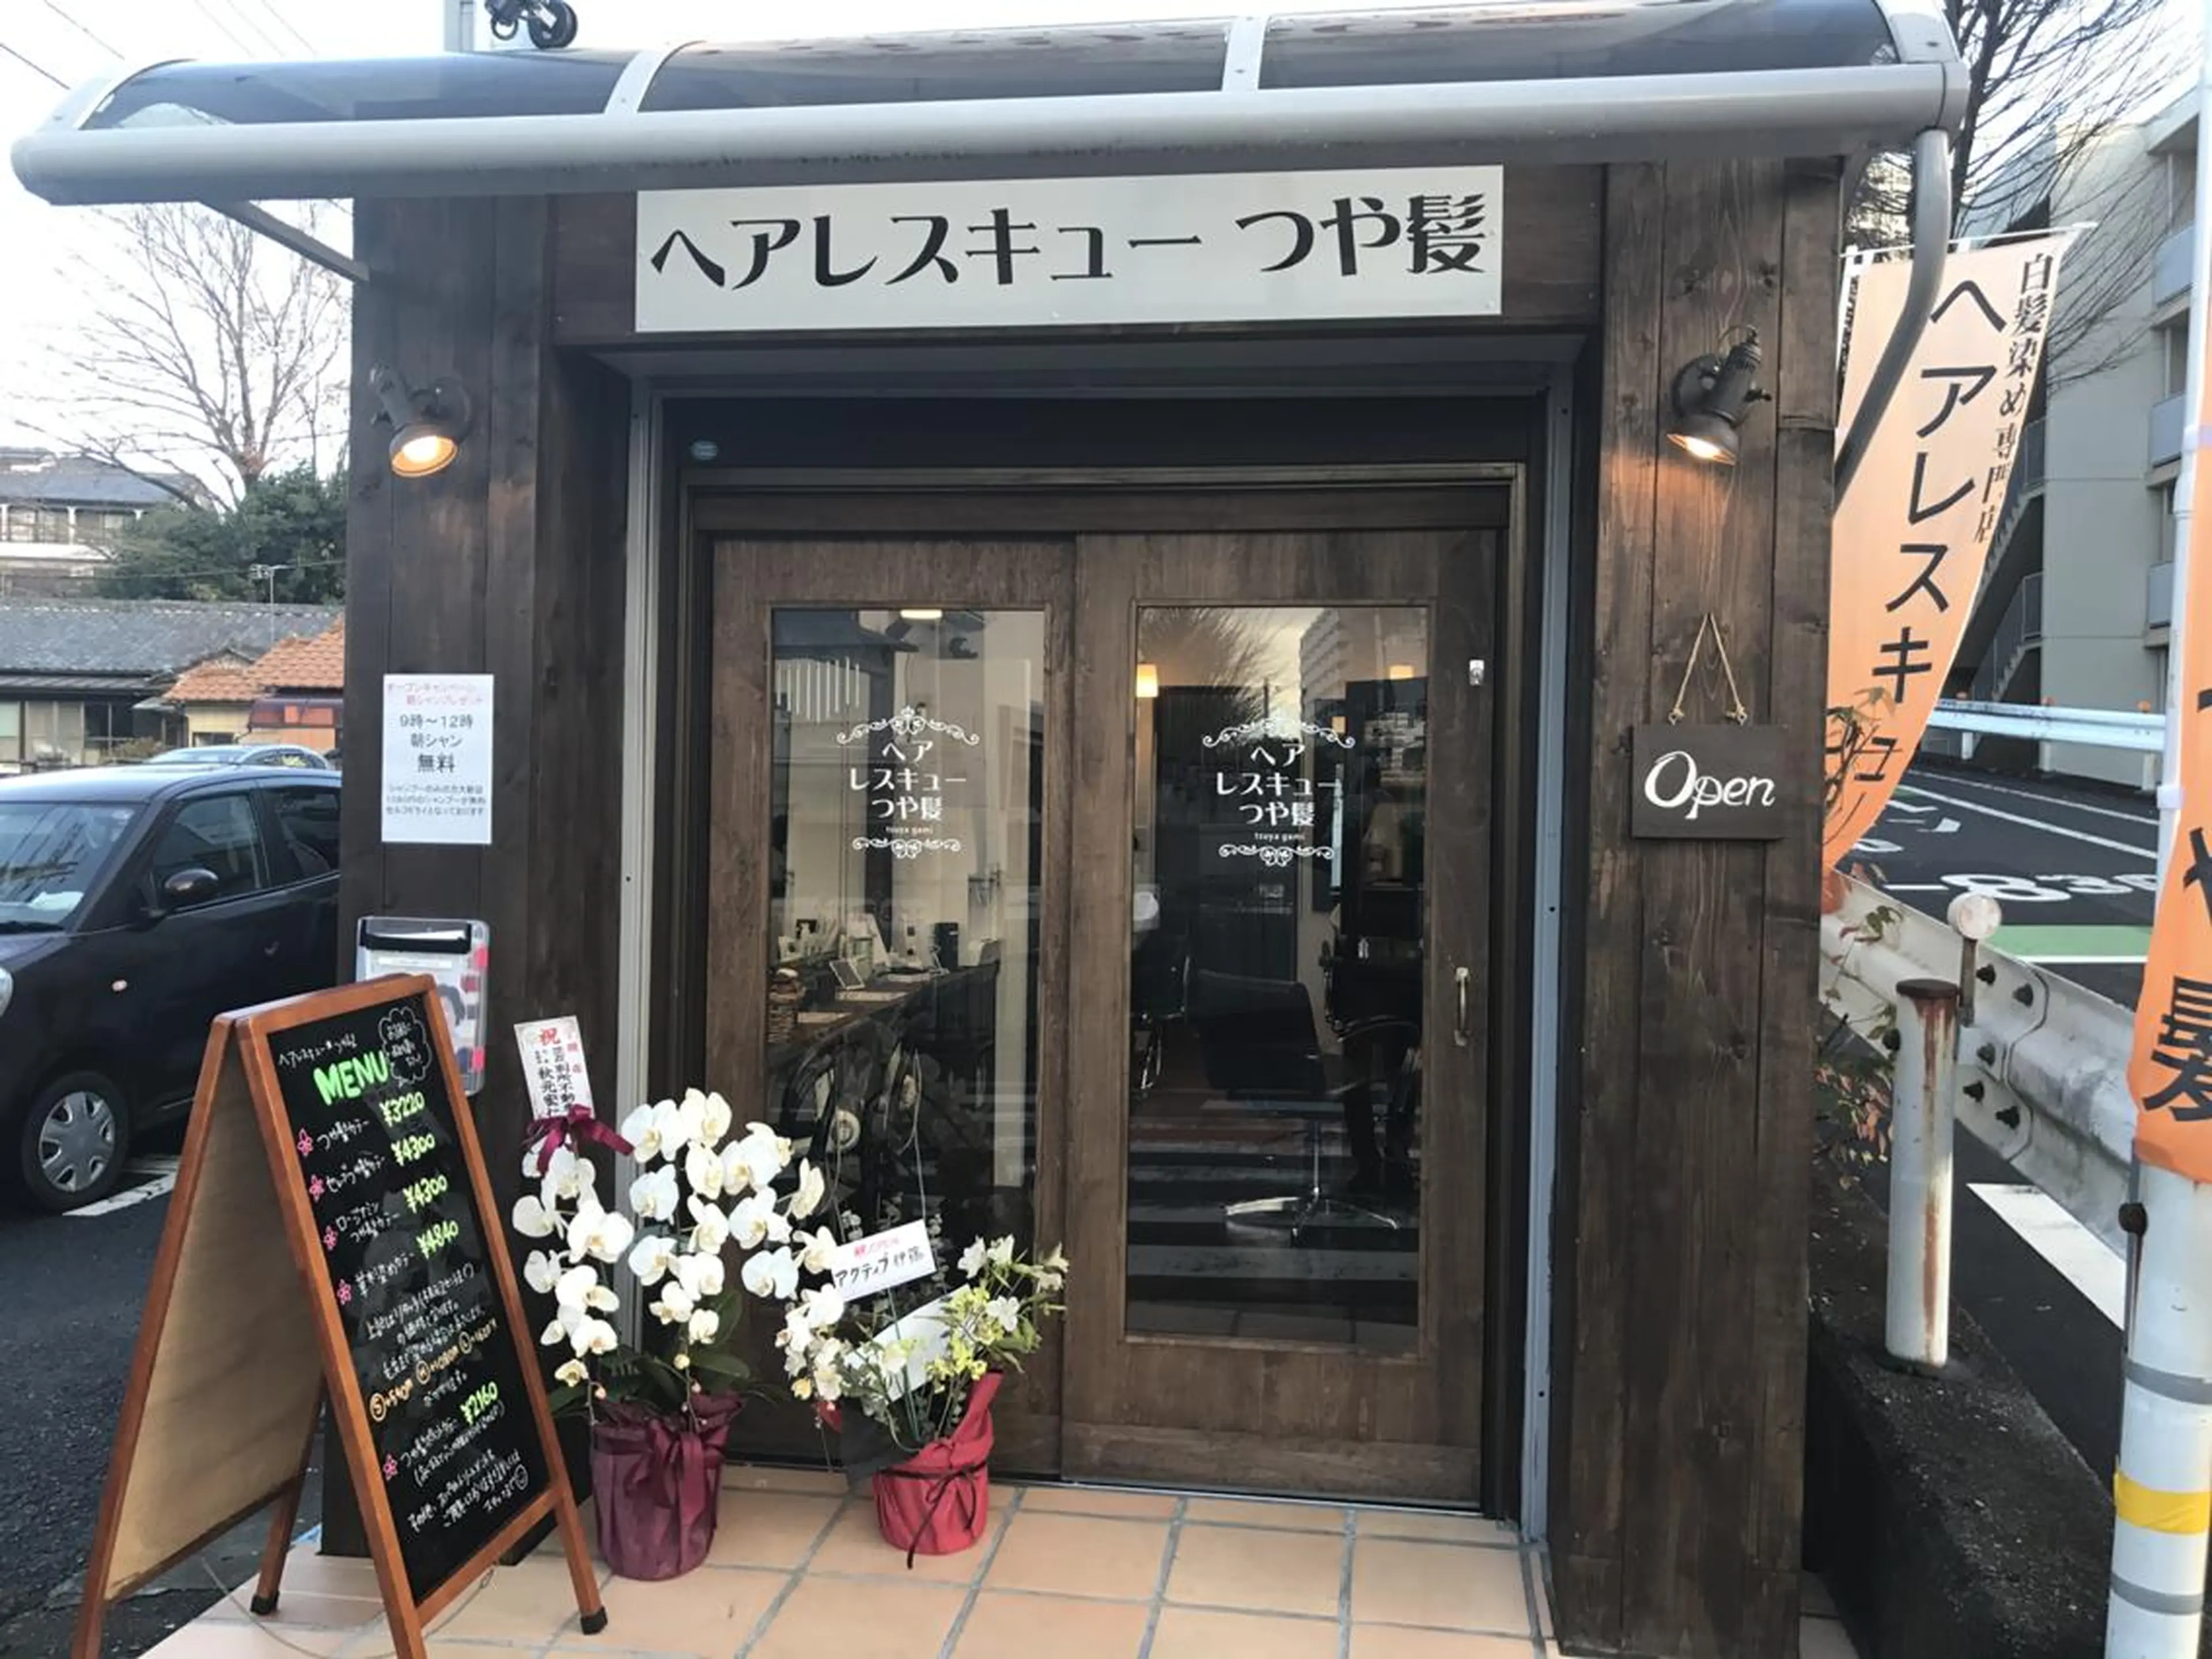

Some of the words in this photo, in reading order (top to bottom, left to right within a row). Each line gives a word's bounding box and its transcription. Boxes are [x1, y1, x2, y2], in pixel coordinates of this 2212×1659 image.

[650, 206, 1203, 290] ヘアレスキュー
[1234, 193, 1487, 276] つや髪
[1975, 253, 2054, 543] 白髪染め専門店
[418, 752, 456, 773] 無料
[881, 740, 934, 763] ヘア
[1250, 743, 1305, 767] ヘア
[850, 768, 967, 791] レスキュー
[1216, 772, 1340, 797] レスキュー
[1644, 750, 1775, 820] Open
[872, 796, 942, 820] つや髪
[1239, 801, 1315, 826] つや髪
[1254, 832, 1279, 842] tsuya
[313, 1050, 389, 1105] MENU
[379, 1092, 425, 1127] ¥3220
[391, 1132, 435, 1166] ¥4300
[403, 1174, 448, 1213] ¥4300
[416, 1220, 459, 1259] ¥4840
[460, 1381, 499, 1425] ¥2160
